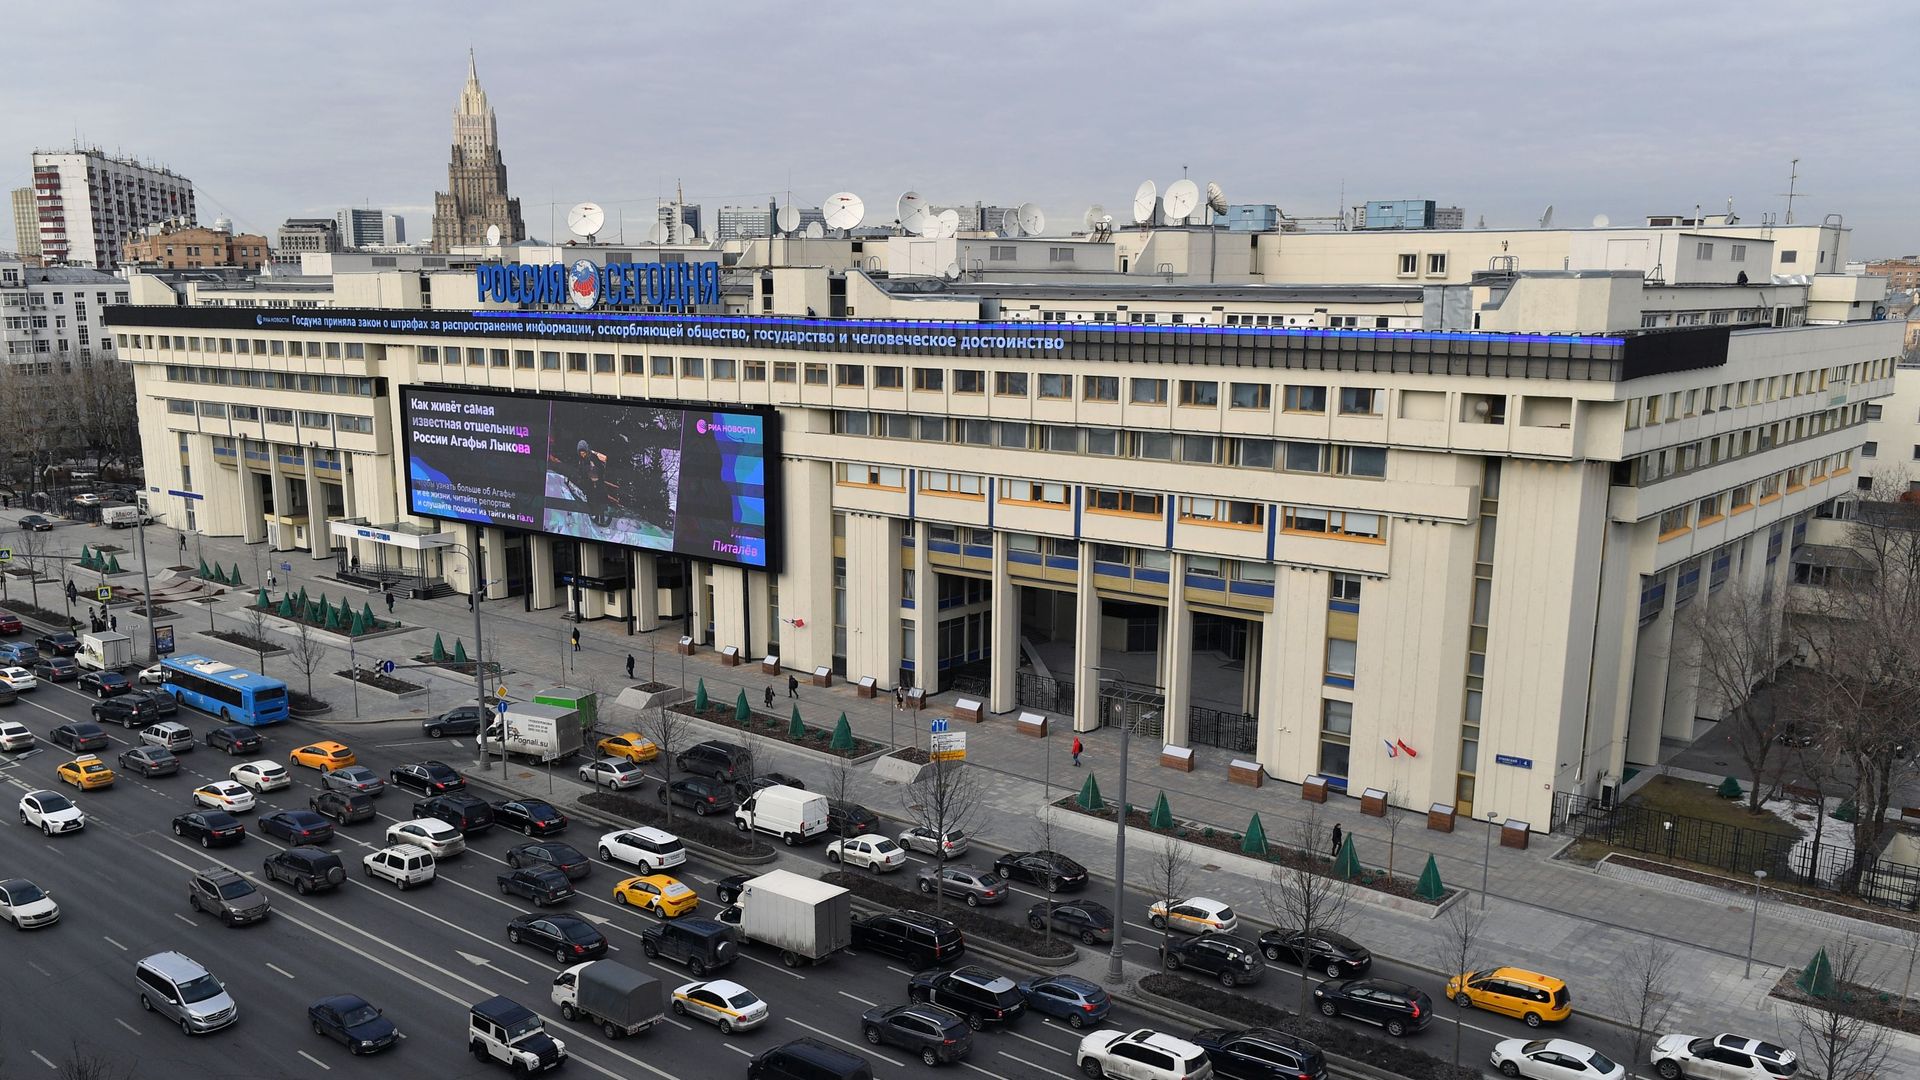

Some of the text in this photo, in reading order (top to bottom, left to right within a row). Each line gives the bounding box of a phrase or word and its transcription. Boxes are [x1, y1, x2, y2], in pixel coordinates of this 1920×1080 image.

[476, 261, 720, 312] РОССИЯ СЕГОДНЯ
[292, 315, 1065, 350] Госдума приняла закон о штрафах за распространение информации, оскорбляющей общество, государство и человеческое достоинство
[411, 398, 495, 416] Как живёт самая
[412, 416, 529, 437] известная отшельница
[708, 423, 756, 435] РИА НОВОСТИ
[413, 431, 531, 454] России Агафья Лыкова
[456, 483, 481, 494] больше
[482, 487, 490, 495] об
[492, 488, 516, 499] Агафье
[453, 493, 478, 504] читайте
[478, 498, 511, 509] репортаж
[422, 500, 452, 510] слушайте
[453, 505, 478, 514] подкаст
[479, 508, 487, 516] из
[488, 510, 505, 518] тайги
[517, 513, 534, 523] ria.ru
[712, 539, 758, 557] Питалёв
[513, 734, 549, 748] Pognali.su
